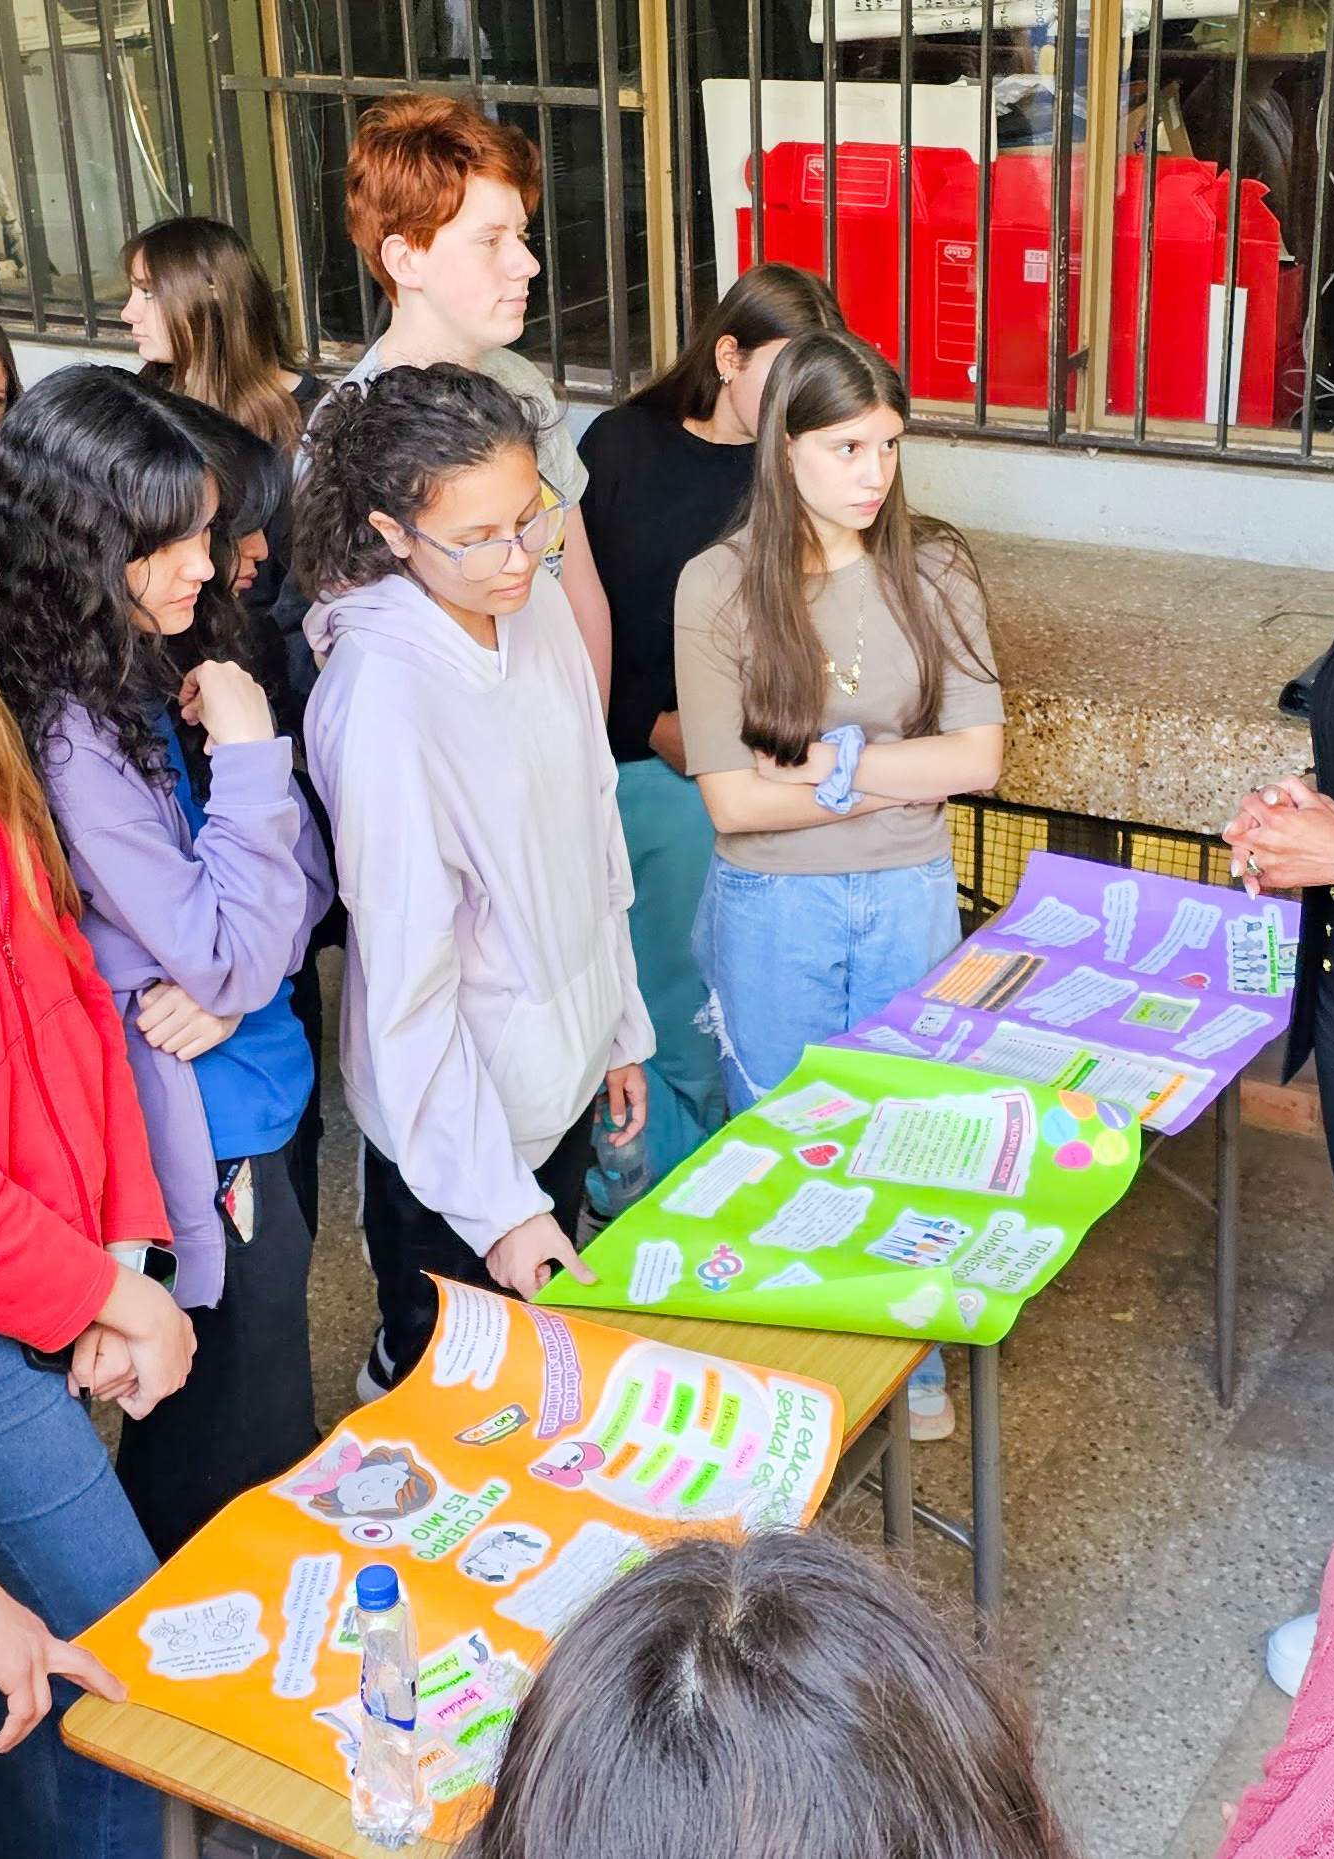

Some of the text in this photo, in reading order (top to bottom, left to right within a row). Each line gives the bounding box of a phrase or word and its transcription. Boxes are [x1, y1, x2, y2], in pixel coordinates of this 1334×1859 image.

[986, 1254, 1012, 1271] MIS
[996, 1239, 1052, 1287] TRATO BIEN
[545, 1333, 560, 1360] vida
[550, 1361, 559, 1381] sin
[563, 1369, 576, 1420] derecho
[800, 1395, 818, 1421] La
[493, 1412, 513, 1427] NO
[751, 1388, 794, 1487] sexual es
[441, 1493, 470, 1514] ES
[415, 1483, 505, 1561] MI CUERPO
[435, 1688, 482, 1721] Igualdad
